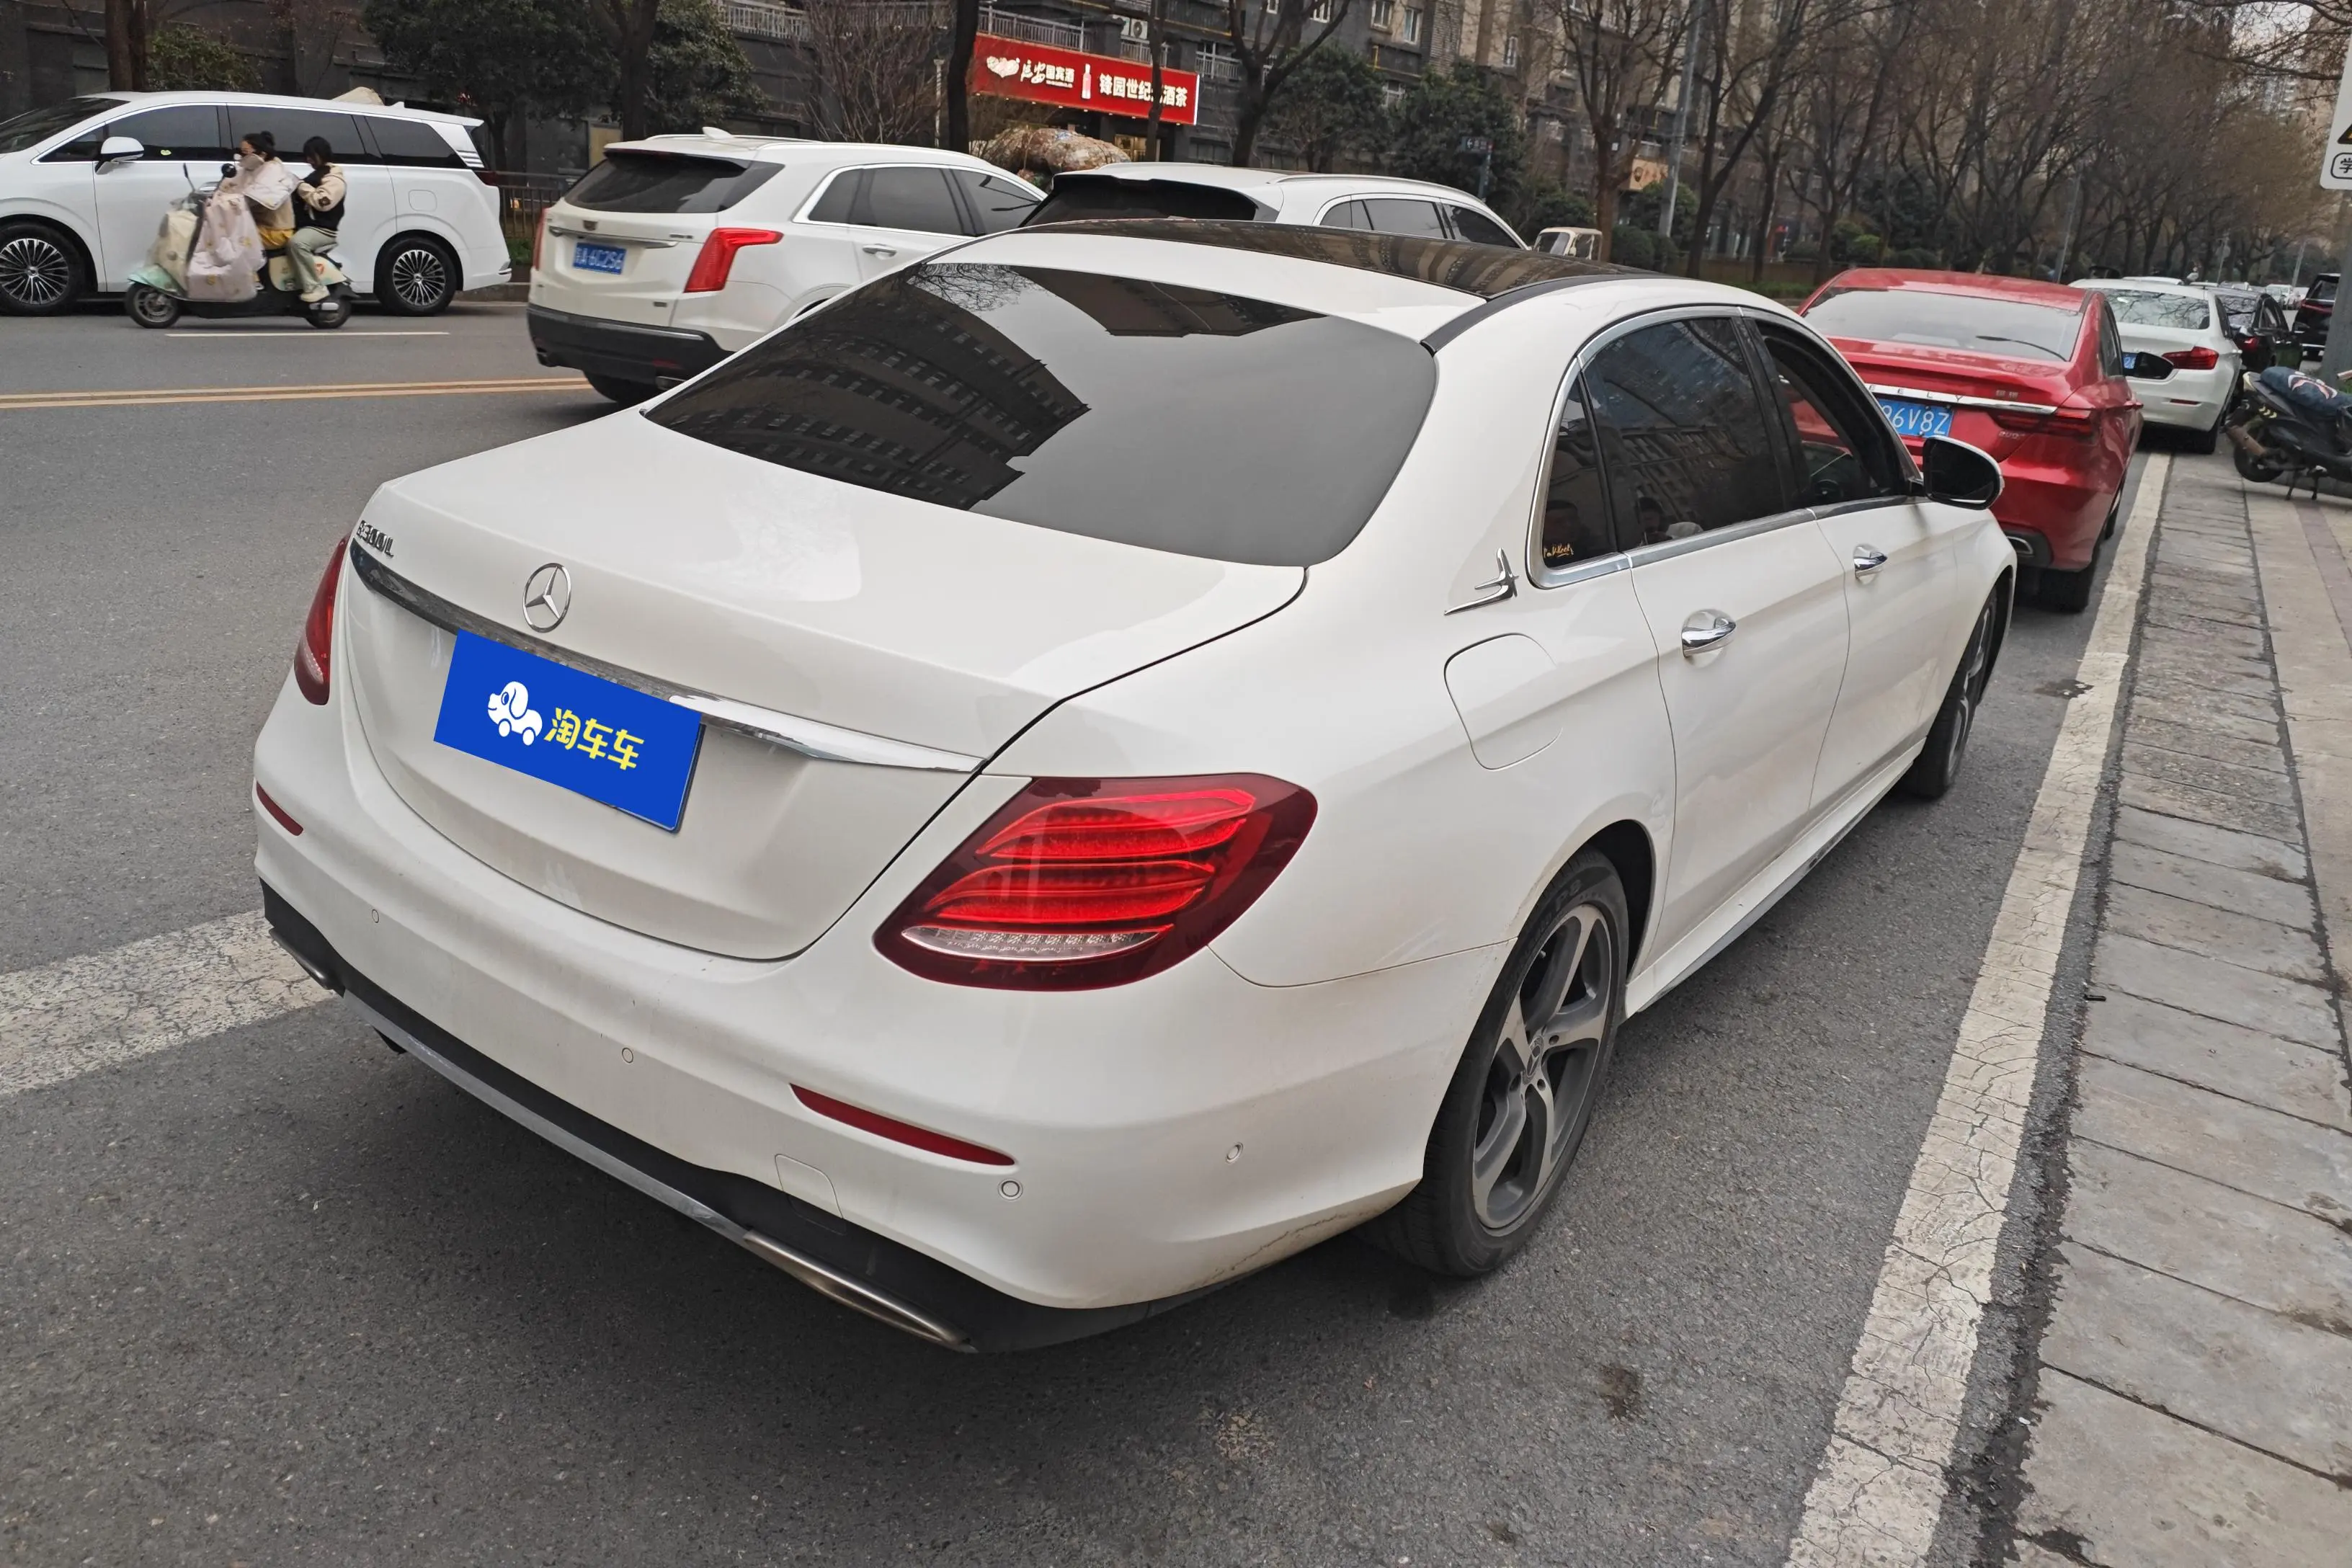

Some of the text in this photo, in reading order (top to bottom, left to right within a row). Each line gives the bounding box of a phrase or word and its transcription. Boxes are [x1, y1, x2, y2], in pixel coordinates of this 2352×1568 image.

[1100, 73, 1188, 107] 锋园世纪酒茶
[1868, 385, 1963, 402] EELY
[1881, 404, 1950, 435] 96V8Z
